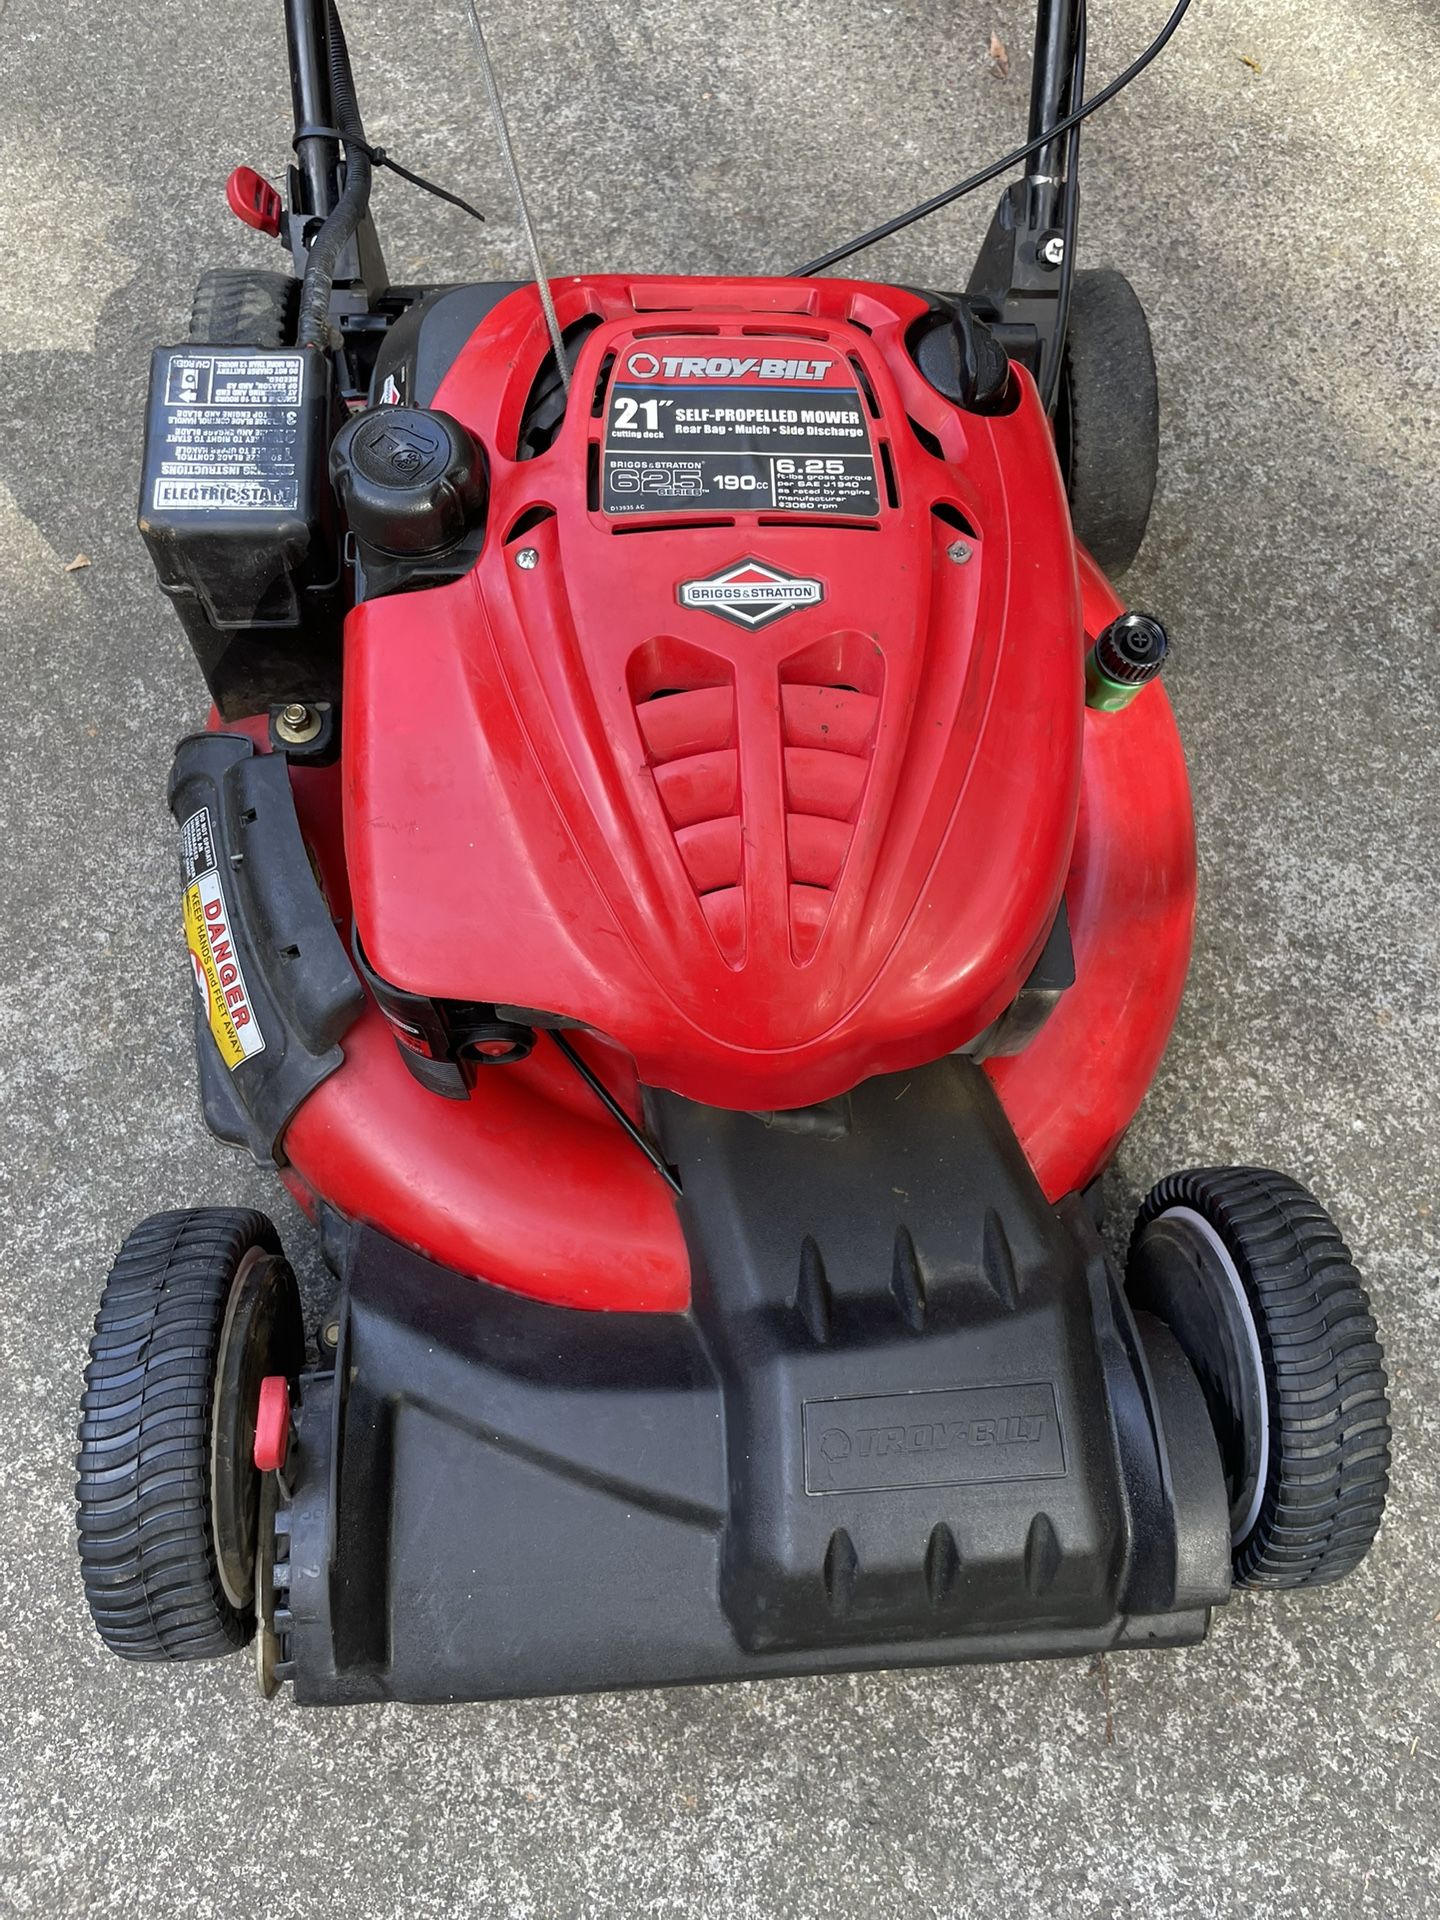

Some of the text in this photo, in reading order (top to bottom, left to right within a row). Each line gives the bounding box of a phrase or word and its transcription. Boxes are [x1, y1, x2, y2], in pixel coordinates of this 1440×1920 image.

[662, 357, 832, 381] TROY-BILT
[286, 411, 297, 425] 3
[675, 408, 860, 424] SELF-PROPELLED MOWER
[612, 430, 664, 439] cutting deck
[675, 425, 864, 438] Rear Bag Mulch Side Discharge
[162, 465, 240, 475] INSTRUCTIONS
[776, 460, 844, 474] 6.25
[610, 469, 703, 493] 625
[163, 486, 236, 500] ELECTRIC
[203, 836, 214, 867] OPERATE
[204, 898, 251, 1031] DANGER
[191, 893, 243, 1055] KEEP HANDS and FEET AWAY
[856, 1414, 1048, 1458] TROY-BILT
